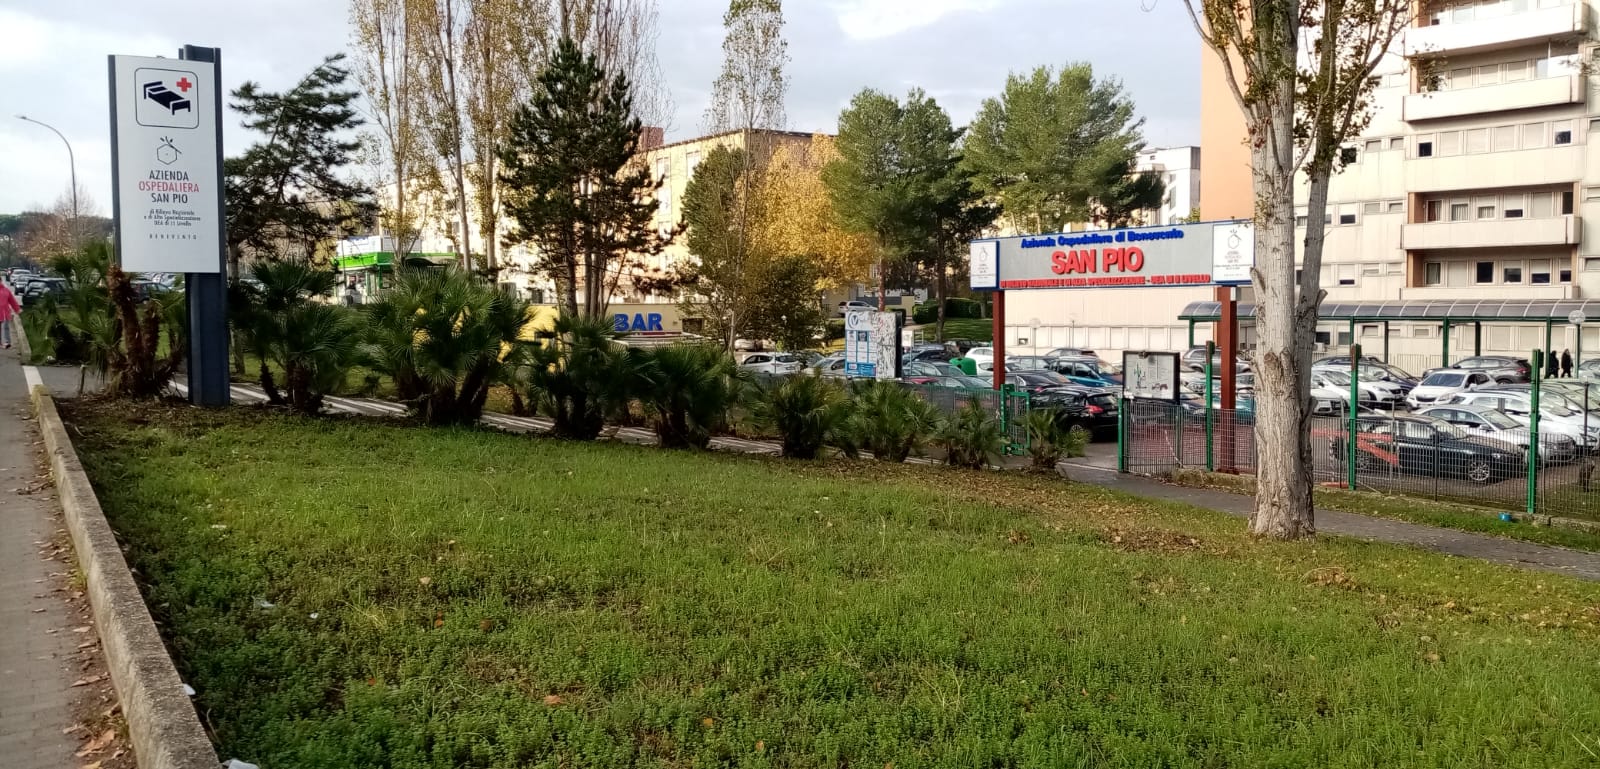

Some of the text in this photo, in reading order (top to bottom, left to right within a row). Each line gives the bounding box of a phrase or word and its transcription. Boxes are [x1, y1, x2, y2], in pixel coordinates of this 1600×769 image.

[149, 169, 190, 181] AZIENDA
[138, 180, 200, 192] OSPEDALIERA
[151, 192, 188, 204] SAN PIO
[1021, 228, 1184, 248] Azienda Ospedaliera di Benevento
[1051, 246, 1145, 275] SAN PIO
[614, 312, 664, 332] BAR
